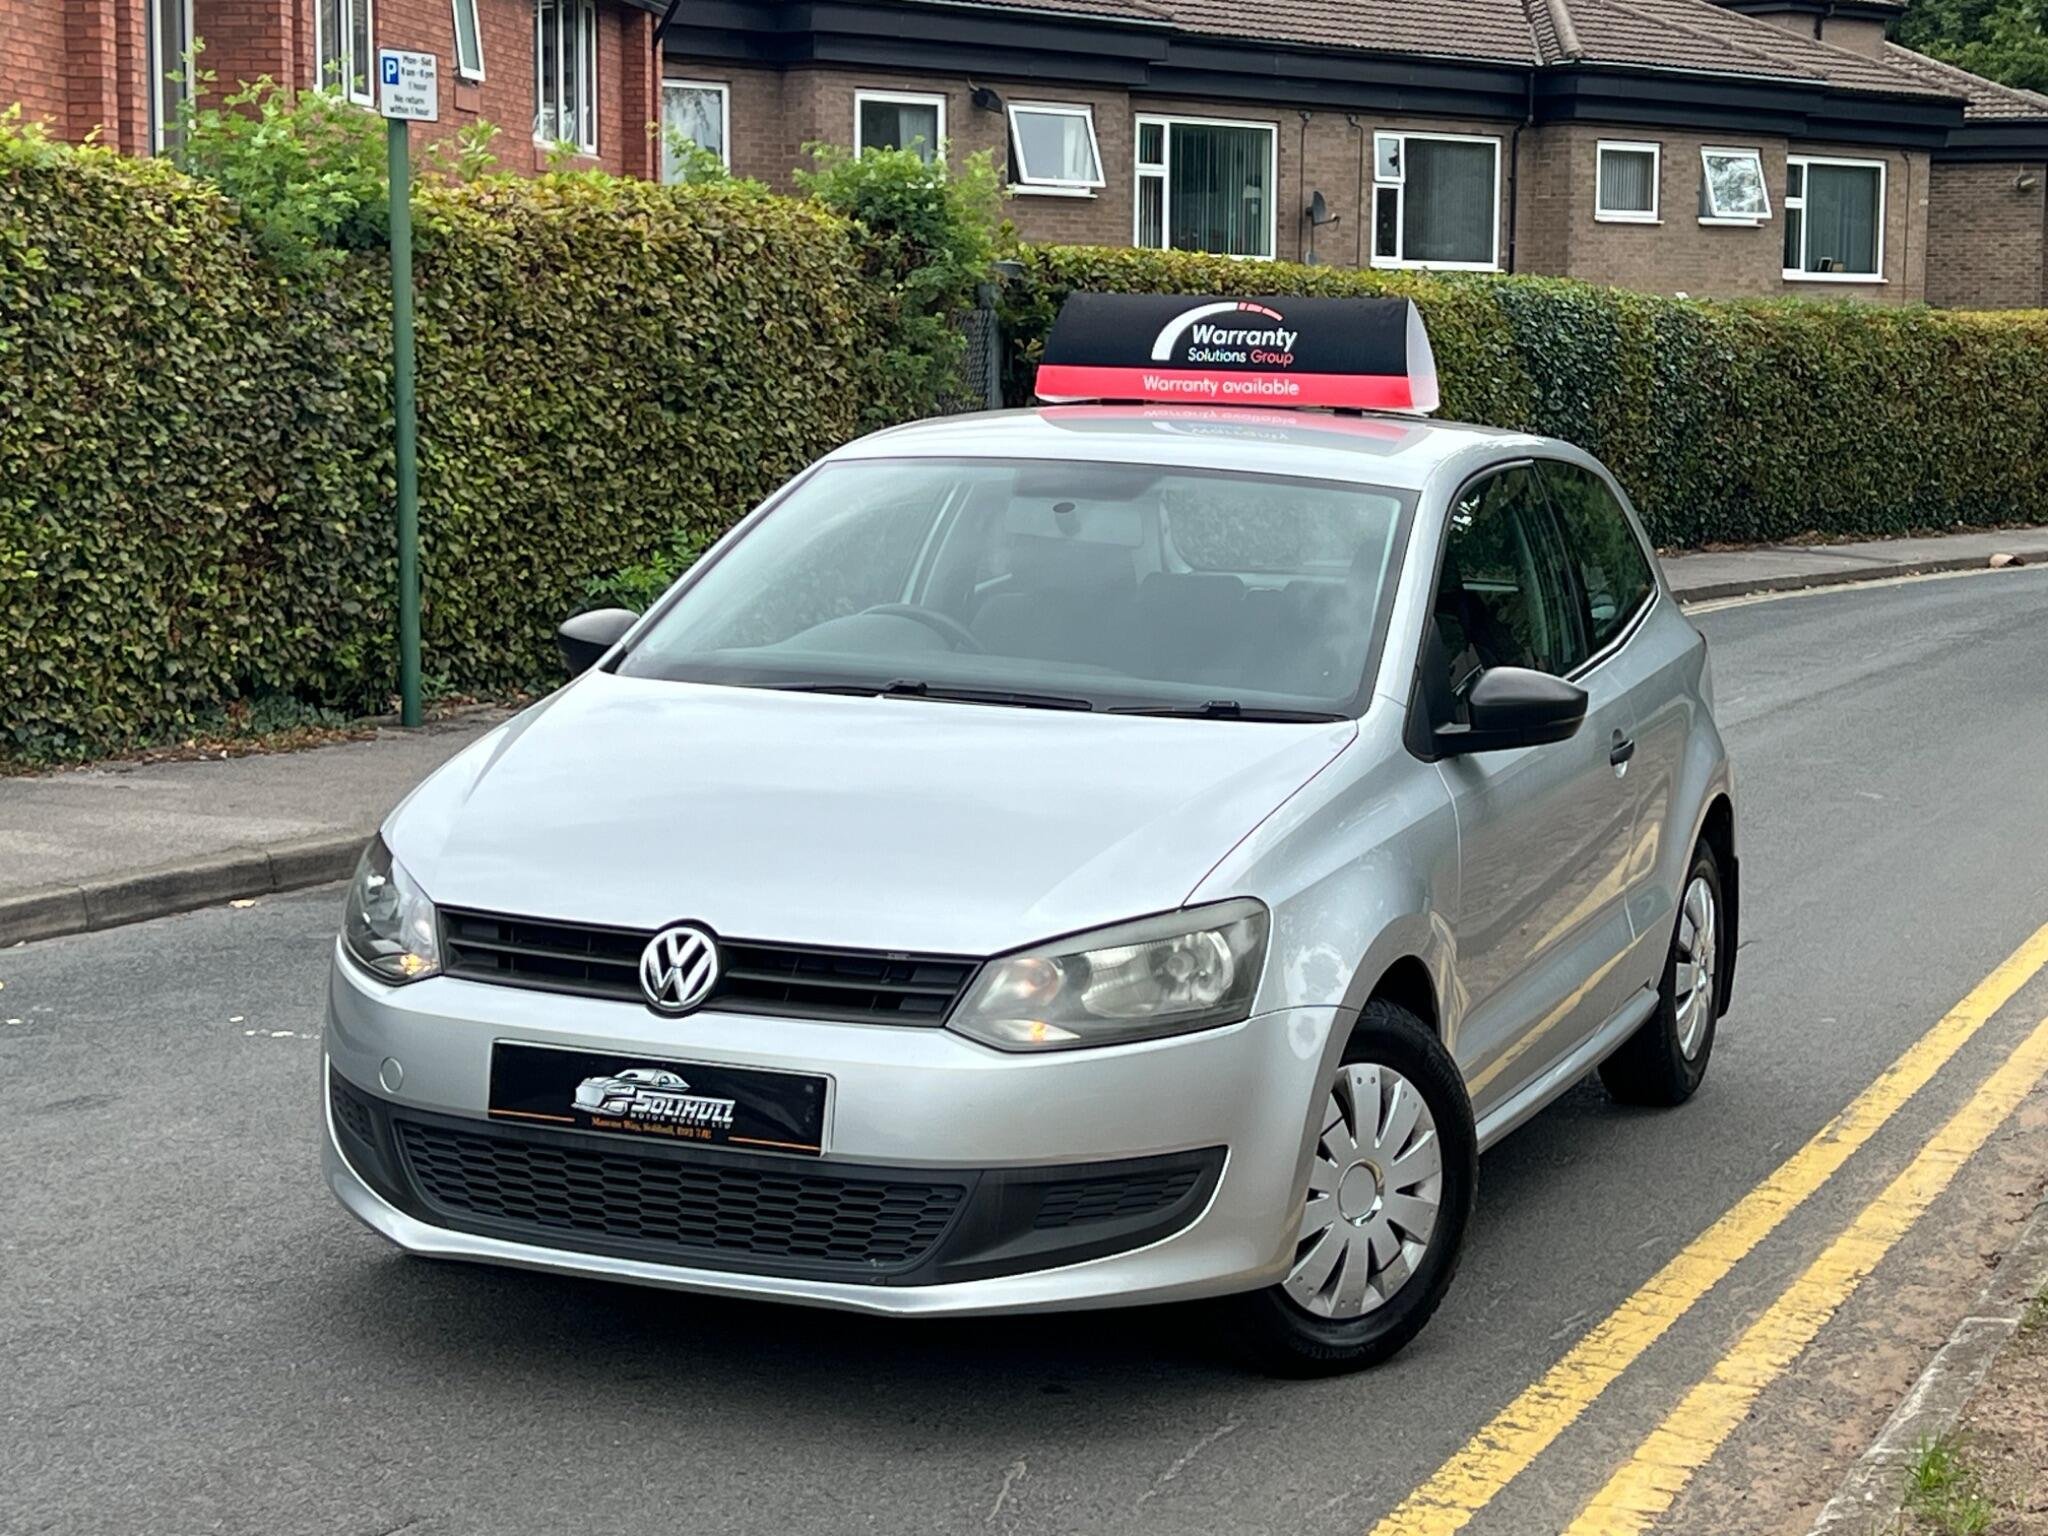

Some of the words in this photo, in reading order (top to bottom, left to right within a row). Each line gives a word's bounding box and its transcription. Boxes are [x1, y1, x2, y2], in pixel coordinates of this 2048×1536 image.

[1192, 324, 1298, 353] Warranty
[1187, 346, 1247, 363] Solutions
[1250, 348, 1294, 368] Group
[1143, 375, 1219, 397] Warranty
[1222, 377, 1299, 395] available
[631, 1089, 736, 1123] SOLIHULL
[630, 1112, 665, 1122] MOTOR
[671, 1116, 706, 1127] HOUSE
